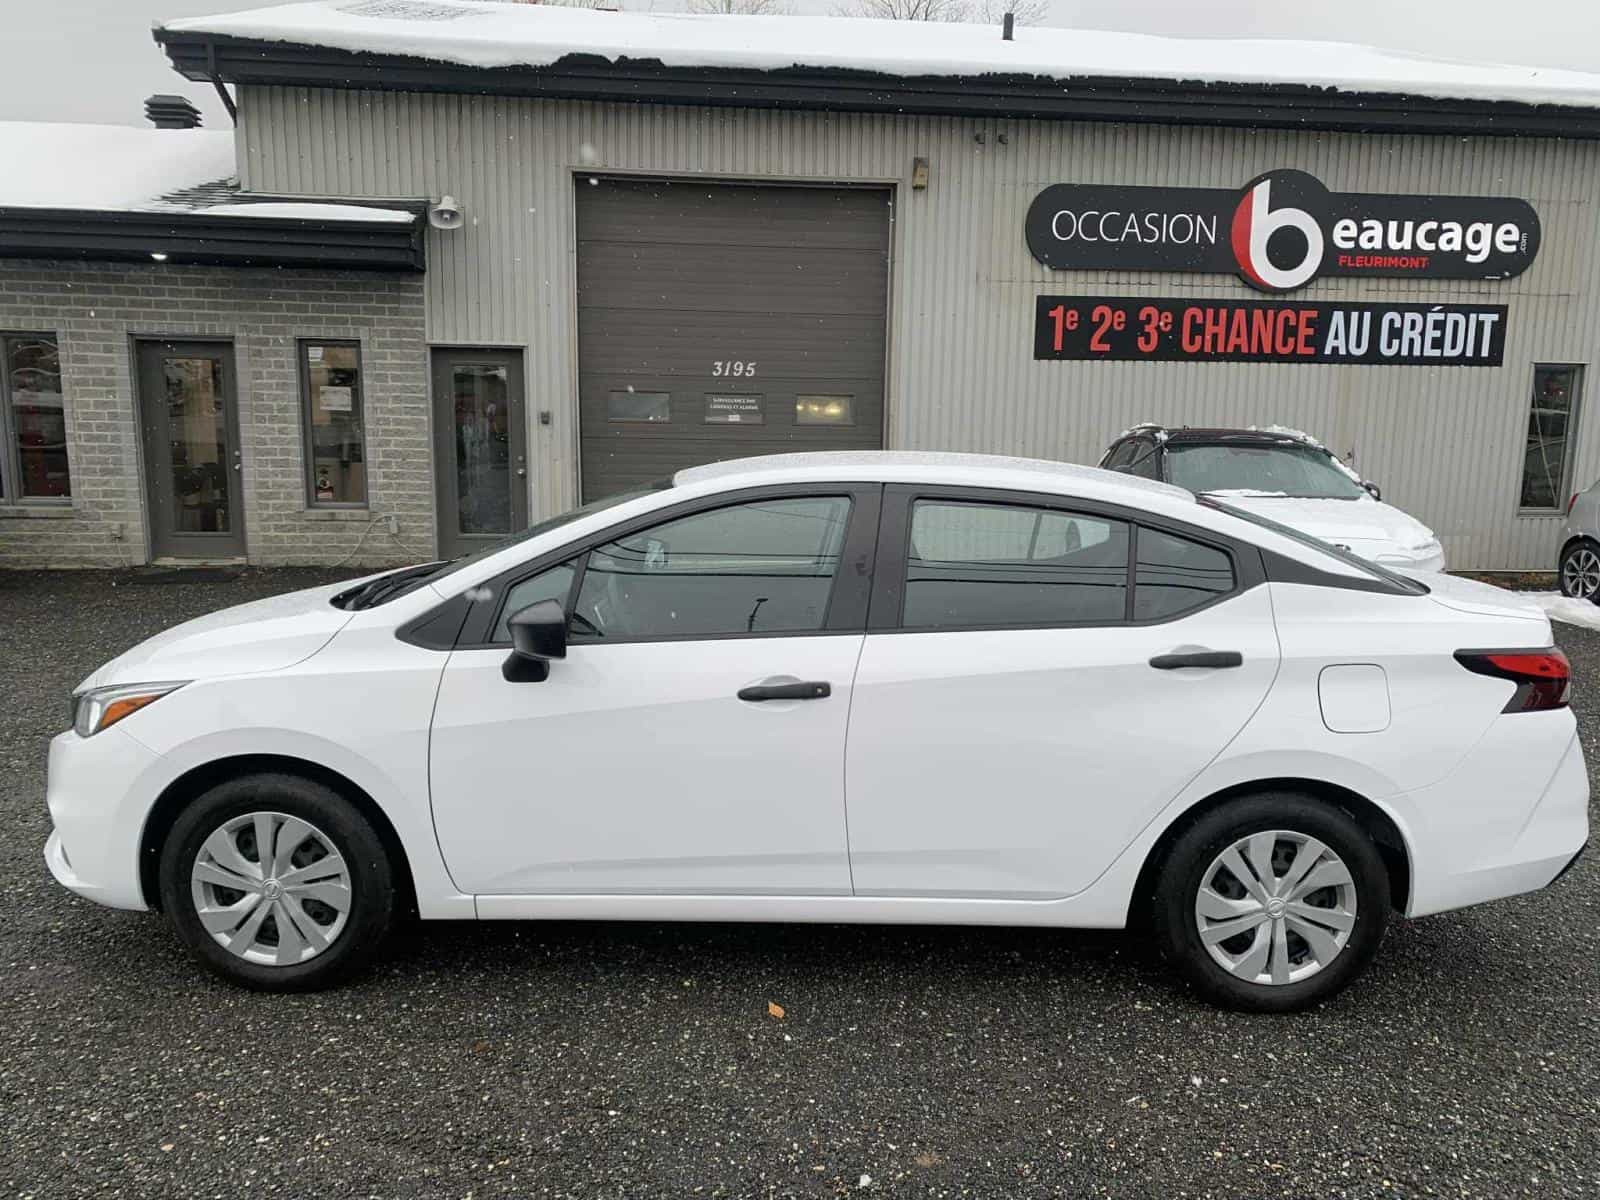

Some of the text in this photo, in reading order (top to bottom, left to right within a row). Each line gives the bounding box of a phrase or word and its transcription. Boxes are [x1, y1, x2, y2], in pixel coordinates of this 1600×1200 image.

[1051, 209, 1217, 245] OCCASION
[1338, 254, 1430, 269] FLEURIMONT
[1048, 304, 1500, 358] 1e 2e 3e CHANCE AU CRÉDIT
[712, 360, 757, 377] 3195
